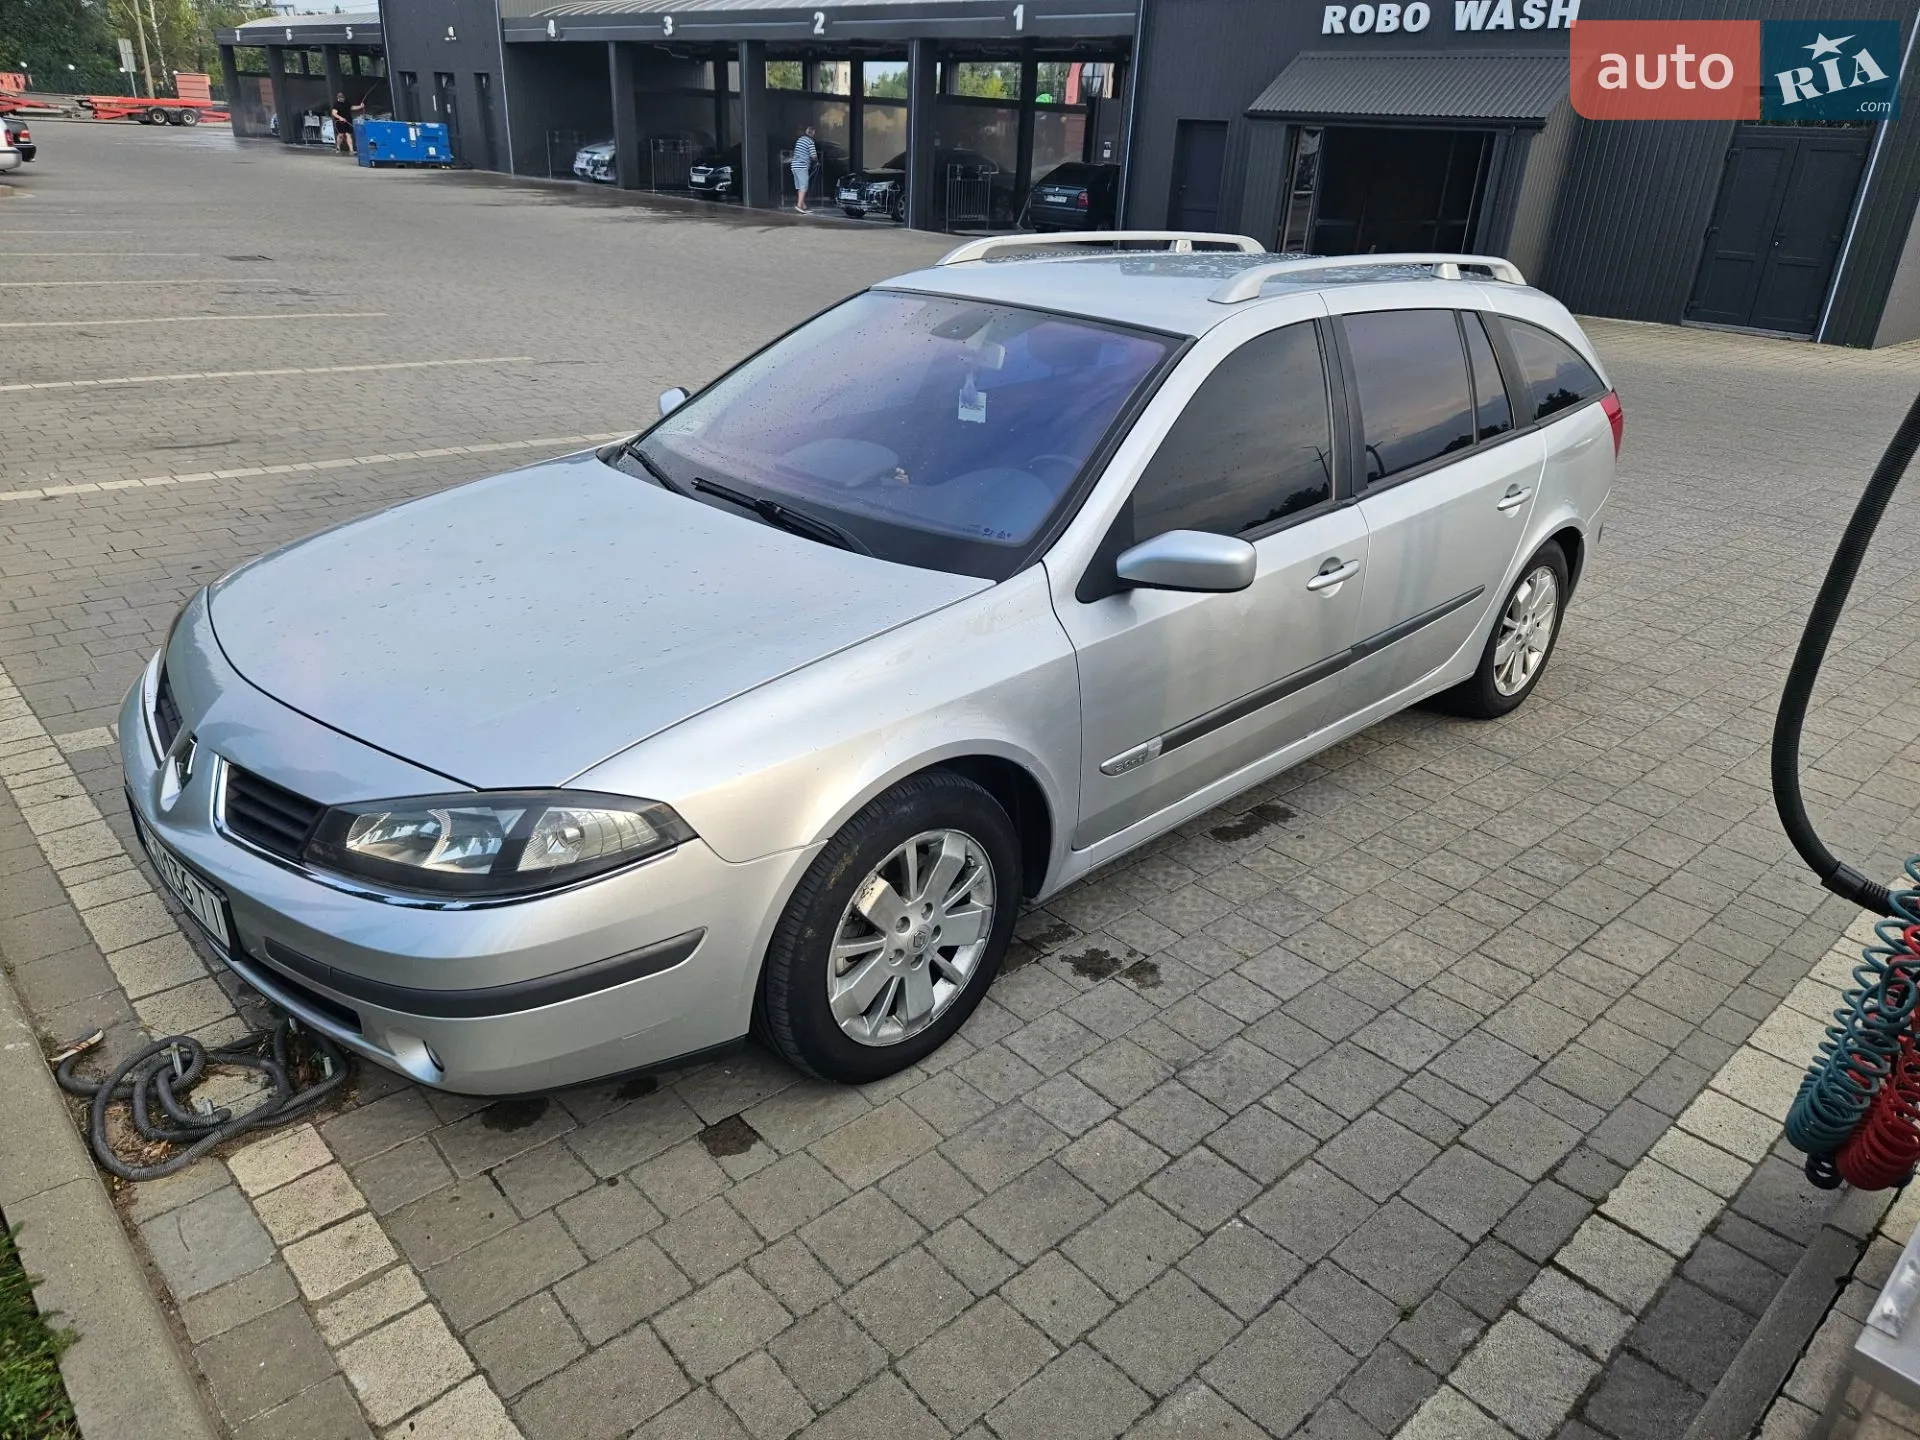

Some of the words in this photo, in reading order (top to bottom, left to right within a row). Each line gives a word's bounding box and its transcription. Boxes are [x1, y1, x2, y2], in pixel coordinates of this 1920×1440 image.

[663, 15, 673, 36] 3
[814, 12, 825, 35] 2
[1013, 4, 1024, 31] 1
[1321, 2, 1431, 34] ROBO
[1454, 0, 1581, 31] WASH
[285, 28, 293, 42] 6
[345, 26, 353, 40] 5
